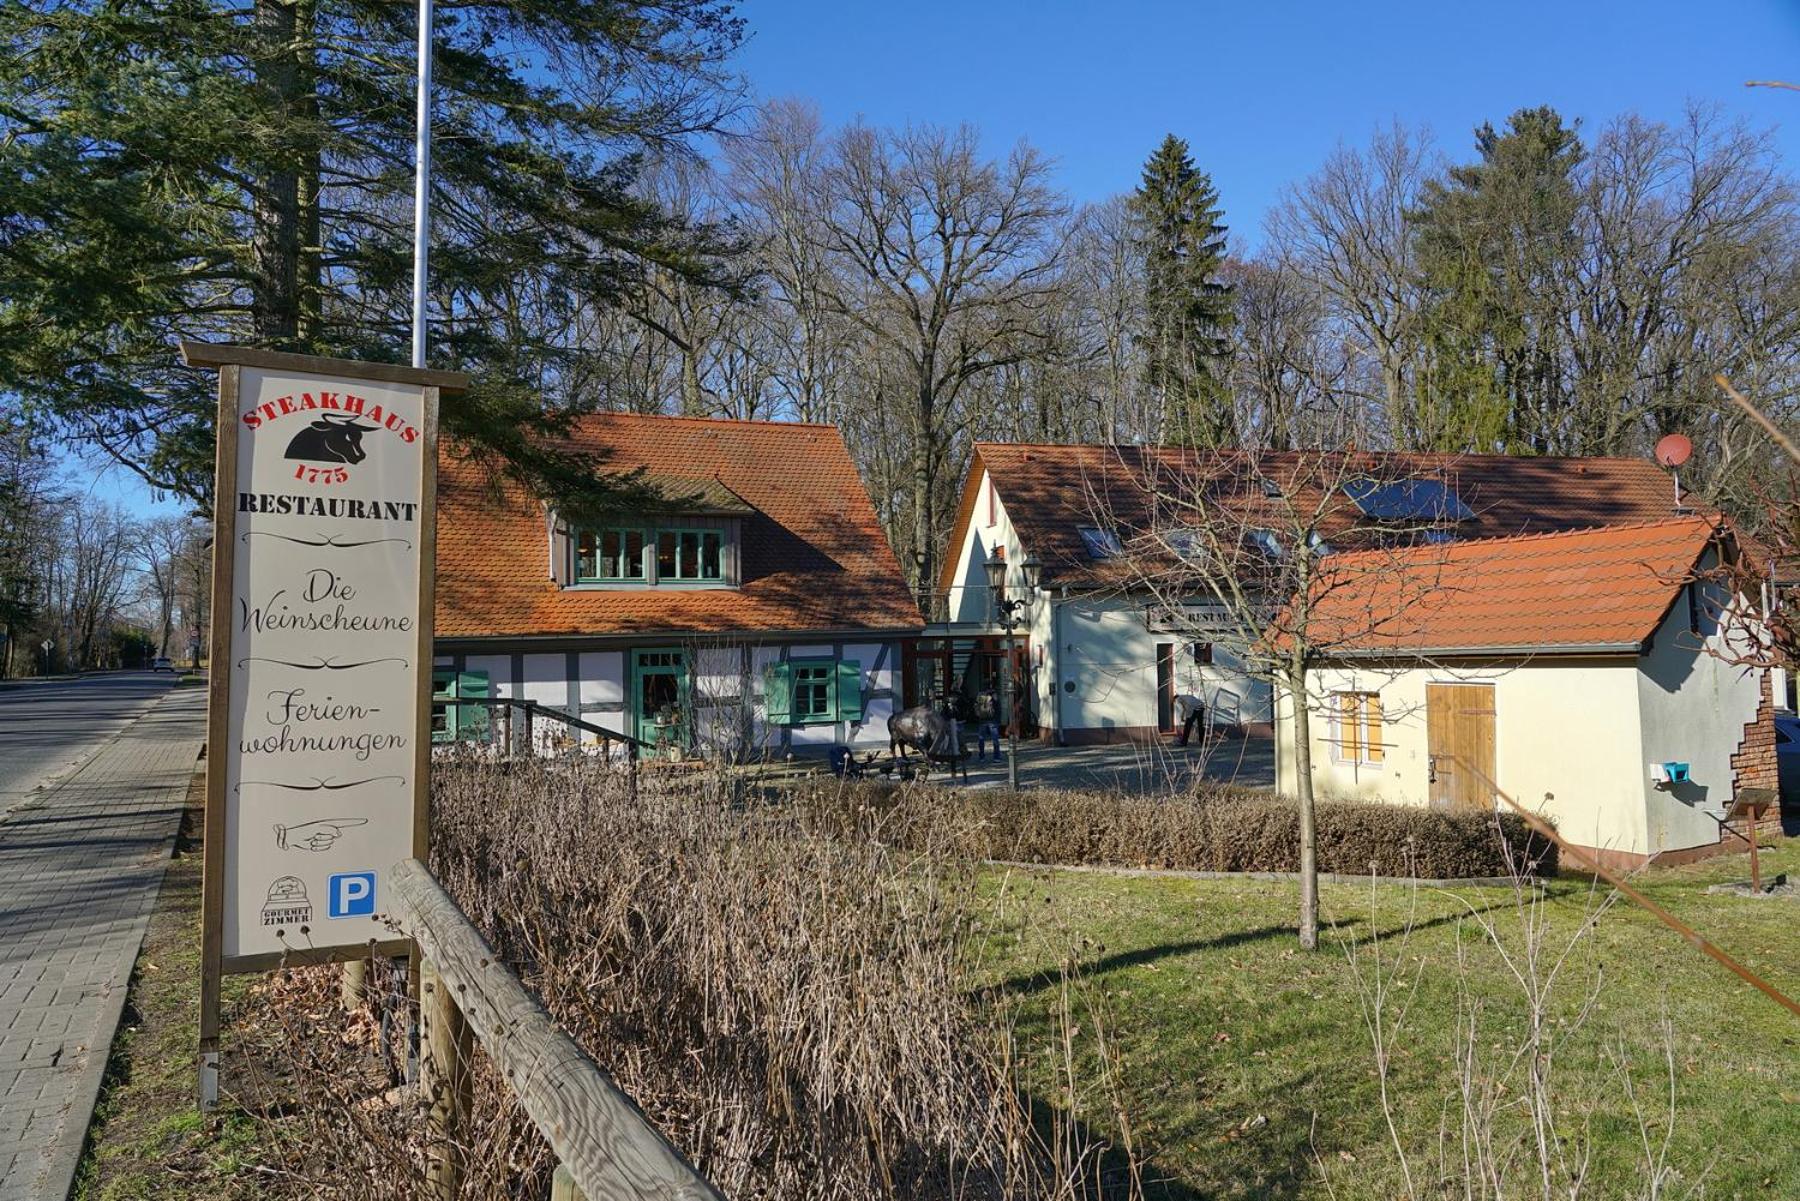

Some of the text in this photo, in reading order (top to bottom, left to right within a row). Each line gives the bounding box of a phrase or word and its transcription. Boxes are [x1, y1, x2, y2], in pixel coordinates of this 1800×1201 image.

[242, 392, 420, 443] STEAKHAUS
[294, 464, 349, 485] 1775
[238, 492, 417, 521] RESTAURANT
[302, 568, 356, 603] Die
[240, 589, 413, 633] Weinscheune
[266, 688, 381, 726] Ferien-
[239, 724, 407, 761] wohnungen
[339, 876, 370, 914] P
[264, 915, 309, 925] ZIMMER
